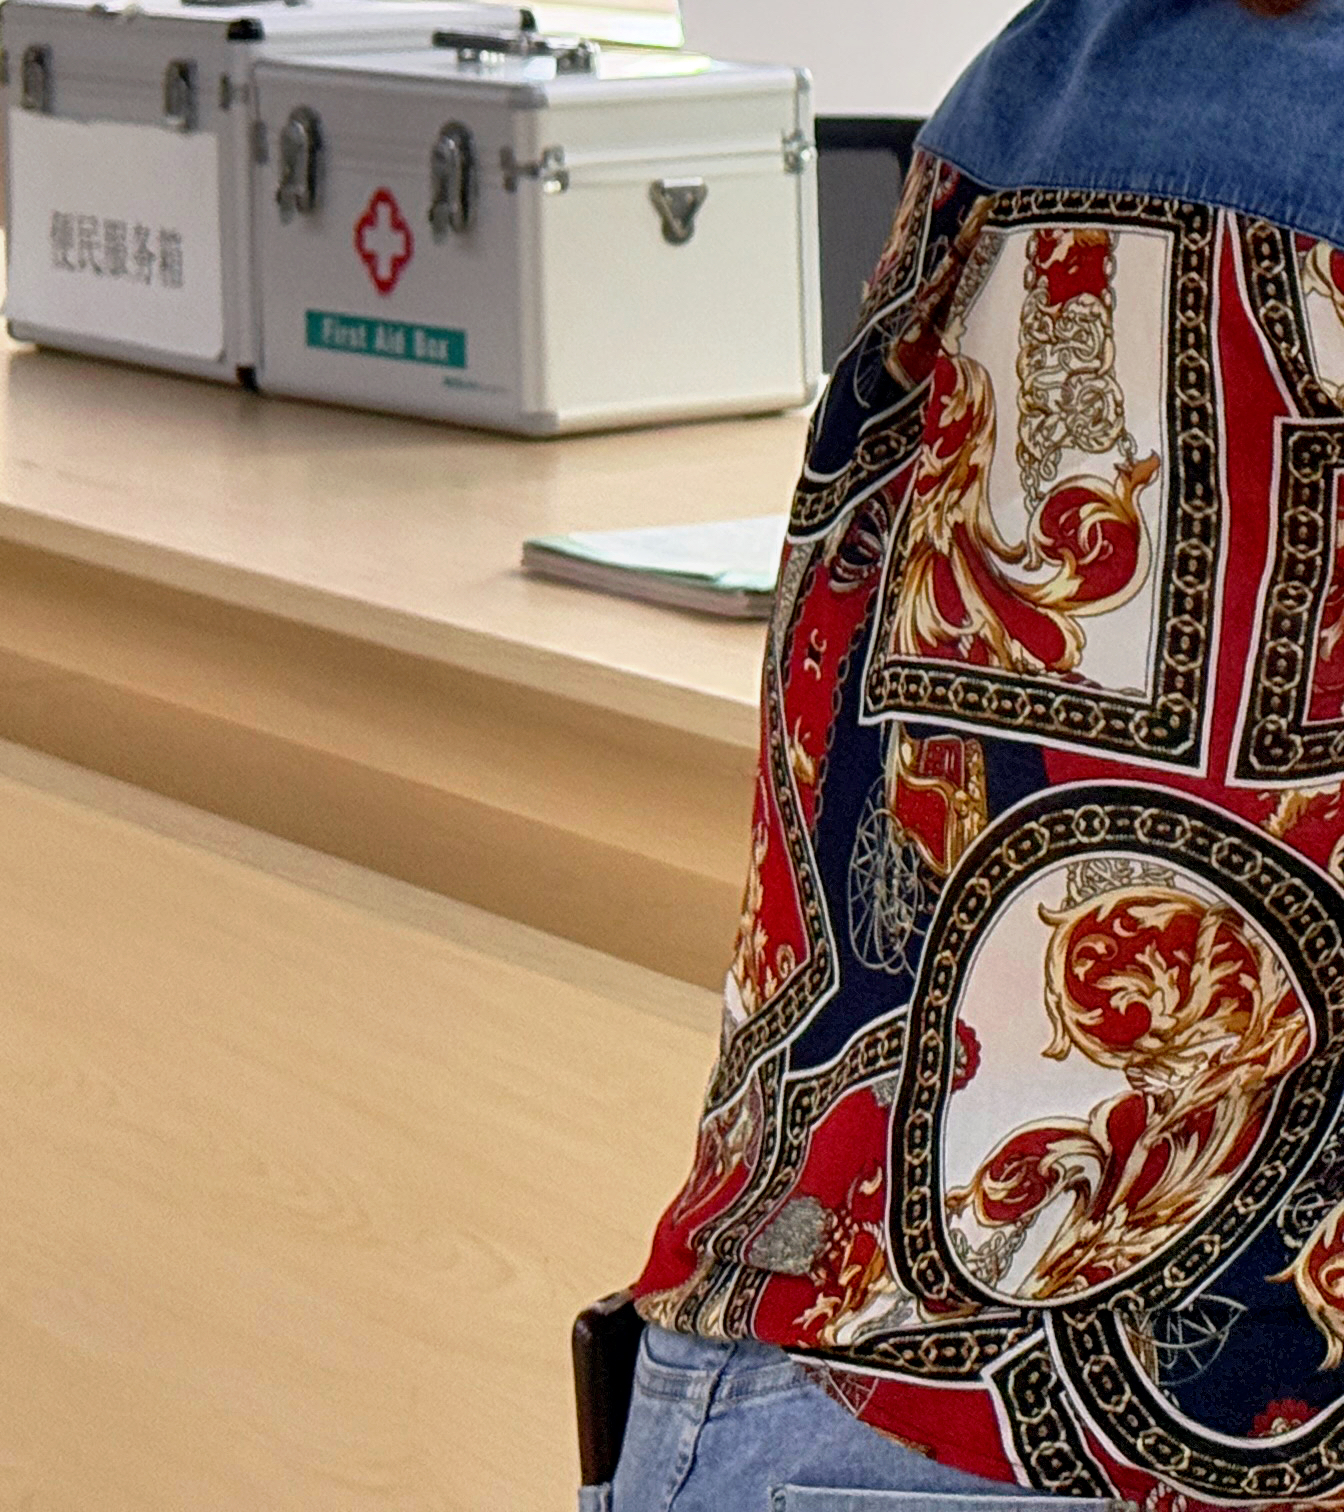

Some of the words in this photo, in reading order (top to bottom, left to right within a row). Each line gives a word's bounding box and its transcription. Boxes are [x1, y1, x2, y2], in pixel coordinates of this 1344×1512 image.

[50, 210, 184, 289] 便民服务箱
[322, 316, 368, 349] First
[375, 324, 406, 355] Aid
[414, 329, 450, 360] Box
